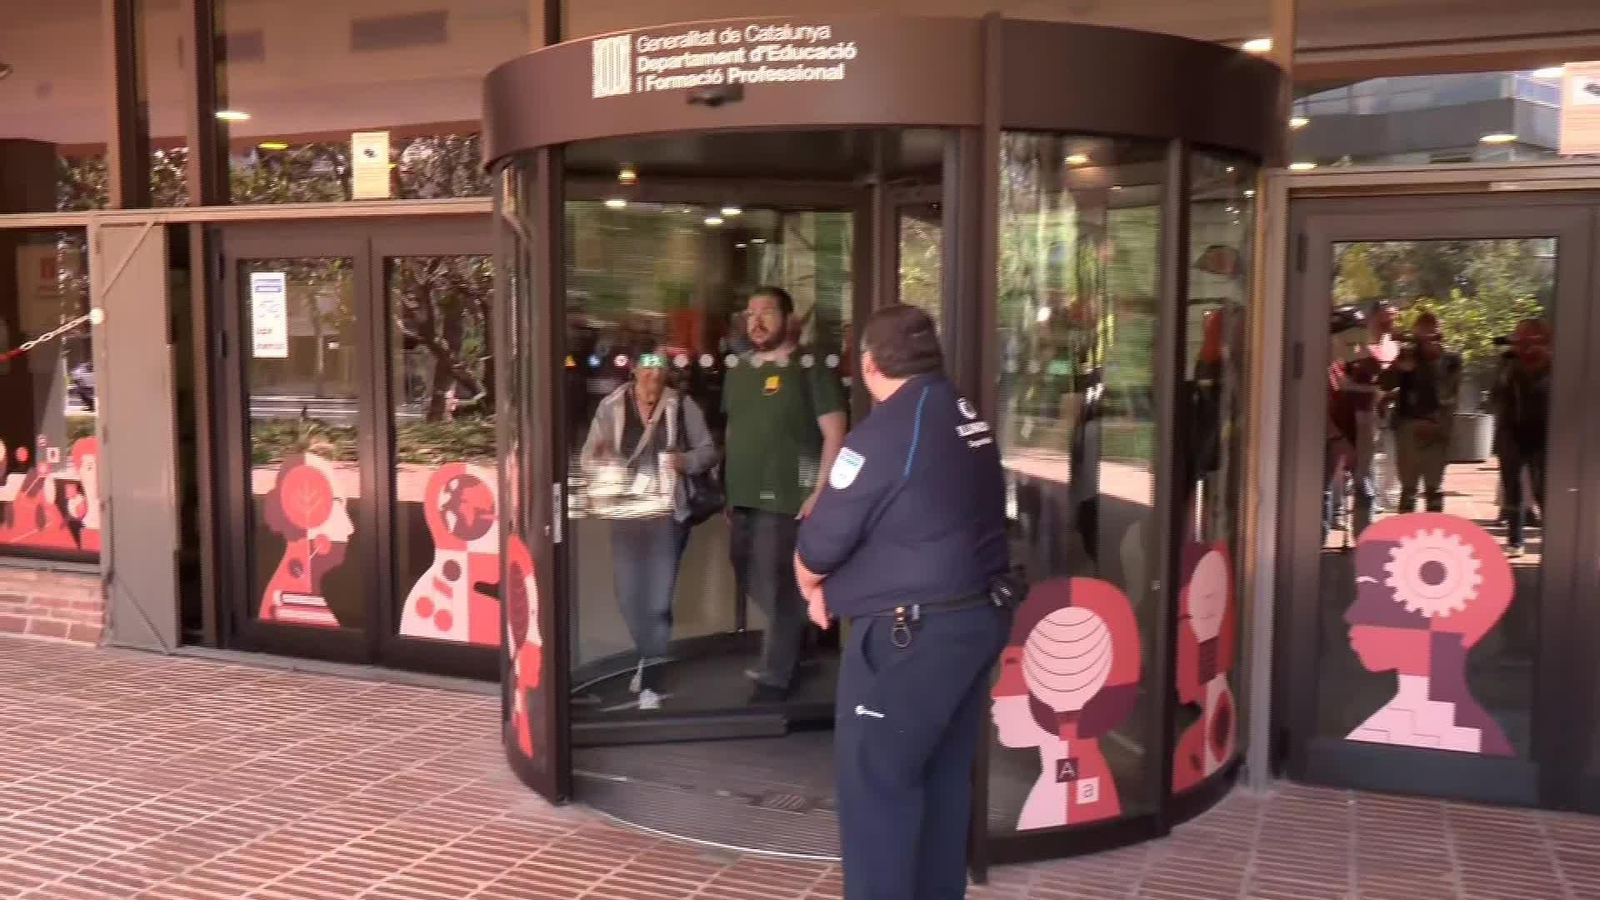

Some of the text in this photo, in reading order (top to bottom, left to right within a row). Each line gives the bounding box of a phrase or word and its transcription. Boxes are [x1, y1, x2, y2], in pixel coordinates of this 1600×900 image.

[637, 24, 832, 53] Generalitat de Catalunya
[636, 42, 858, 74] Departament d'Educació
[645, 68, 724, 92] Formació
[727, 63, 845, 84] Professional
[1059, 761, 1076, 779] A
